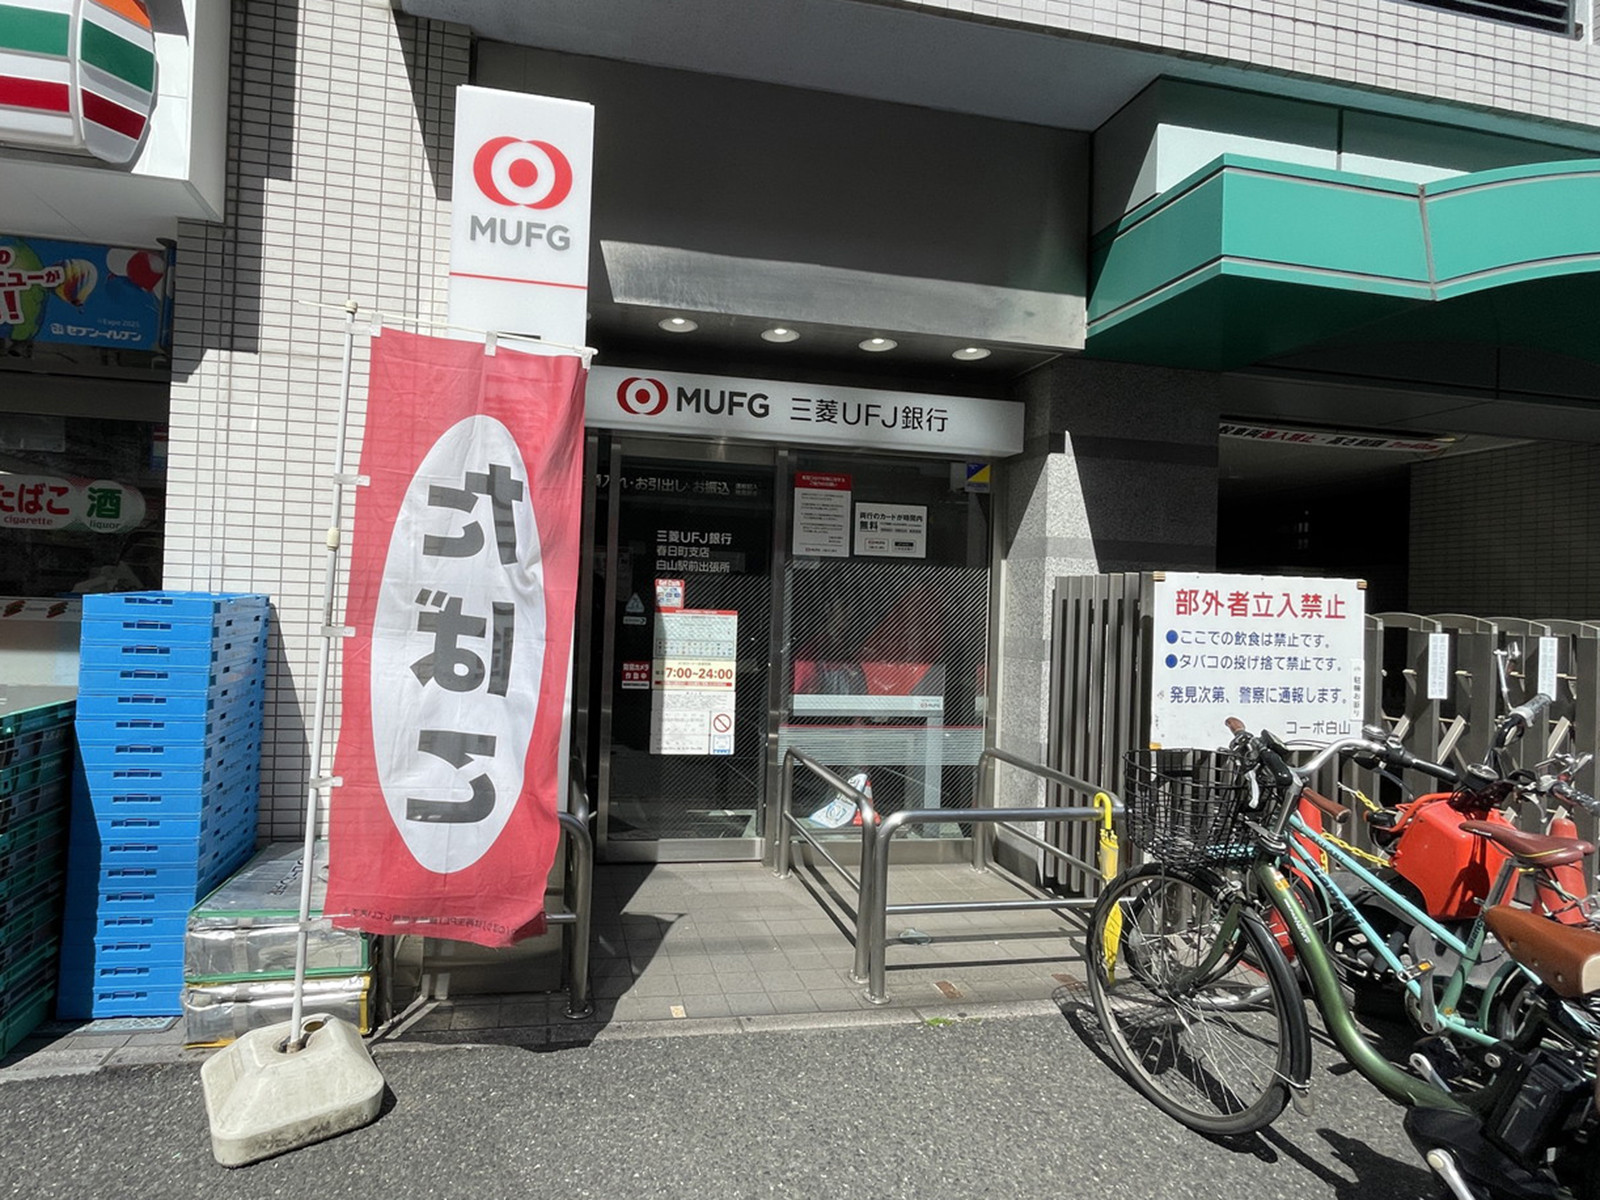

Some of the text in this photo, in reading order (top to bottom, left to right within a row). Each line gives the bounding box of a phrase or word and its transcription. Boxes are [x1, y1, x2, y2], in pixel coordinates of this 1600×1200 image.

[470, 215, 571, 252] MUFG
[676, 387, 949, 433] MUFG 三菱UFJ銀行
[86, 487, 122, 519] 酒
[4, 516, 121, 529] cigarette liquor
[860, 521, 878, 531] 無料
[656, 530, 732, 545] 三菱UFJ銀行
[656, 545, 709, 558] 春日町支店
[656, 559, 730, 573] 白山駅前出張所
[1175, 589, 1346, 620] 部外者立入禁止
[1180, 630, 1330, 649] ここでの飲食は禁止です。
[1180, 654, 1342, 672] タバコの投げ捨て禁止です。
[1170, 686, 1347, 704] 発見次第、警察に通報します。
